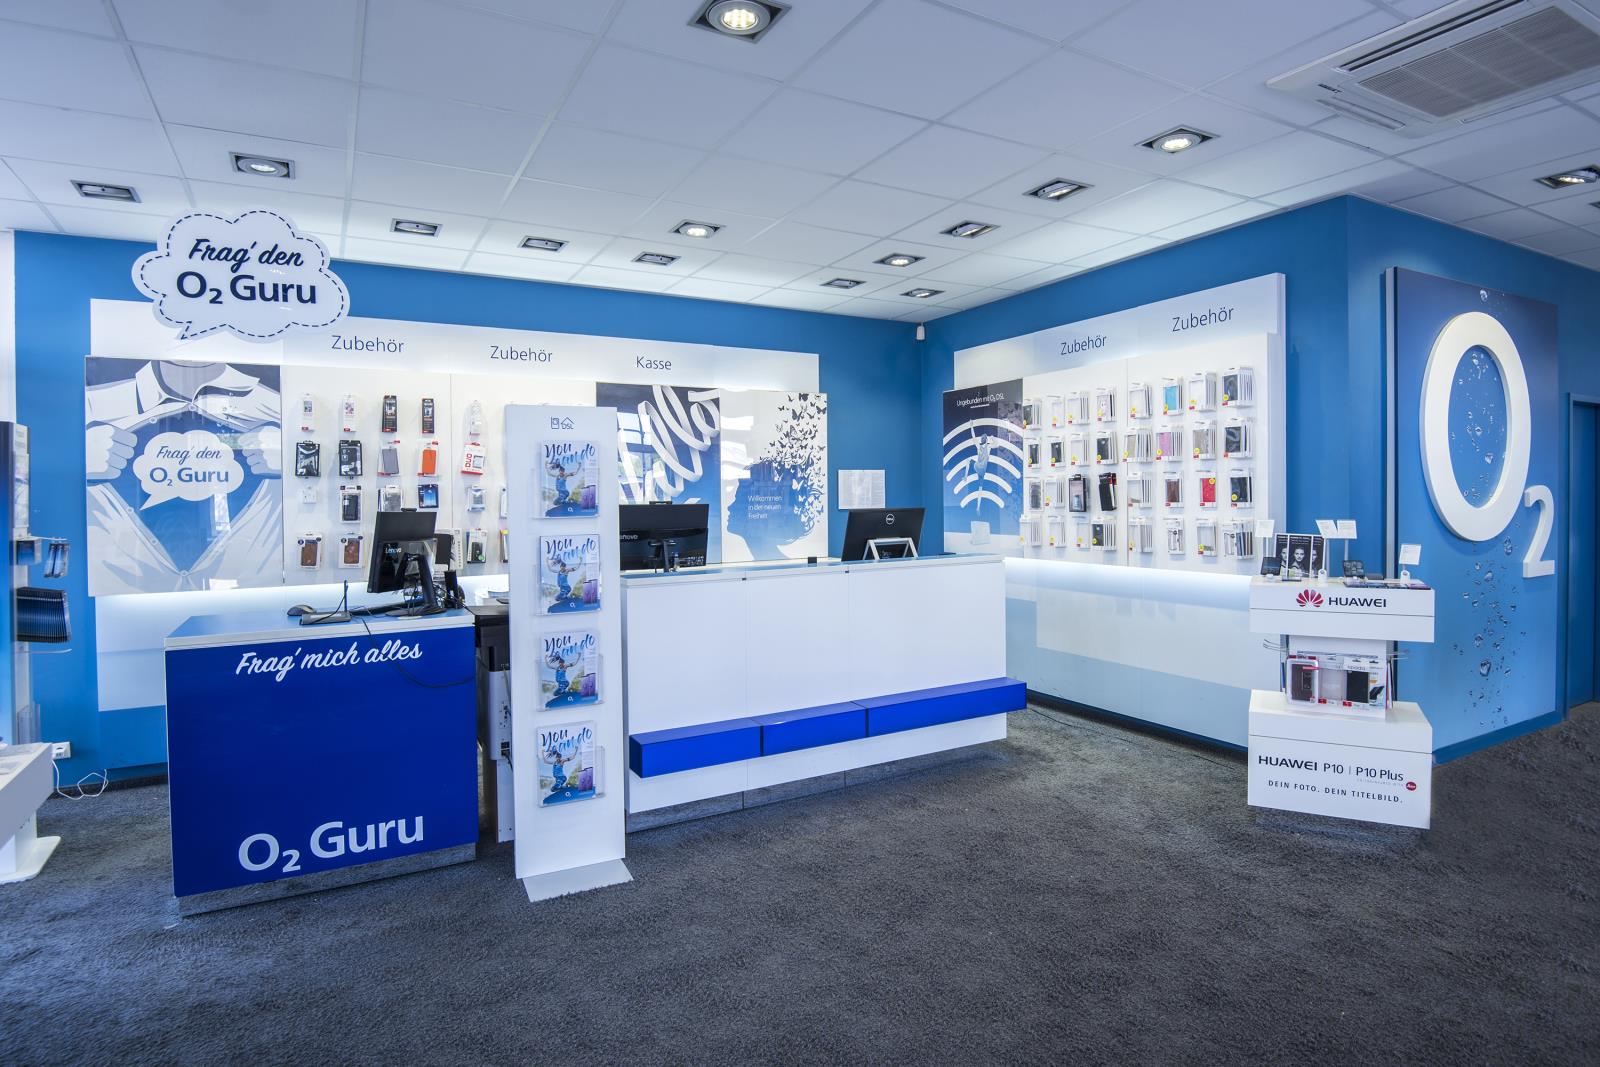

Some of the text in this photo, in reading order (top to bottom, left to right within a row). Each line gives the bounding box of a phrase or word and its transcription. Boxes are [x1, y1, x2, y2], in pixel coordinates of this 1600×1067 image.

[189, 238, 304, 273] Frag' den
[230, 274, 317, 304] Guru
[1172, 306, 1234, 332] Zubehör
[331, 334, 405, 353] Zubehör
[490, 345, 553, 363] Zubehör
[1060, 334, 1107, 355] Zubehör
[636, 356, 673, 371] Kasse
[196, 446, 221, 459] den
[1420, 311, 1556, 579] O2
[177, 467, 229, 483] Guru
[1328, 597, 1387, 608] HUAWEI
[300, 641, 360, 670] mich
[364, 639, 423, 664] alles
[1258, 755, 1404, 782] HUAWEI P10 P10 Plus
[1268, 780, 1403, 803] DEIN FOTO. DEIN TITELBILD.
[309, 815, 424, 859] Guru
